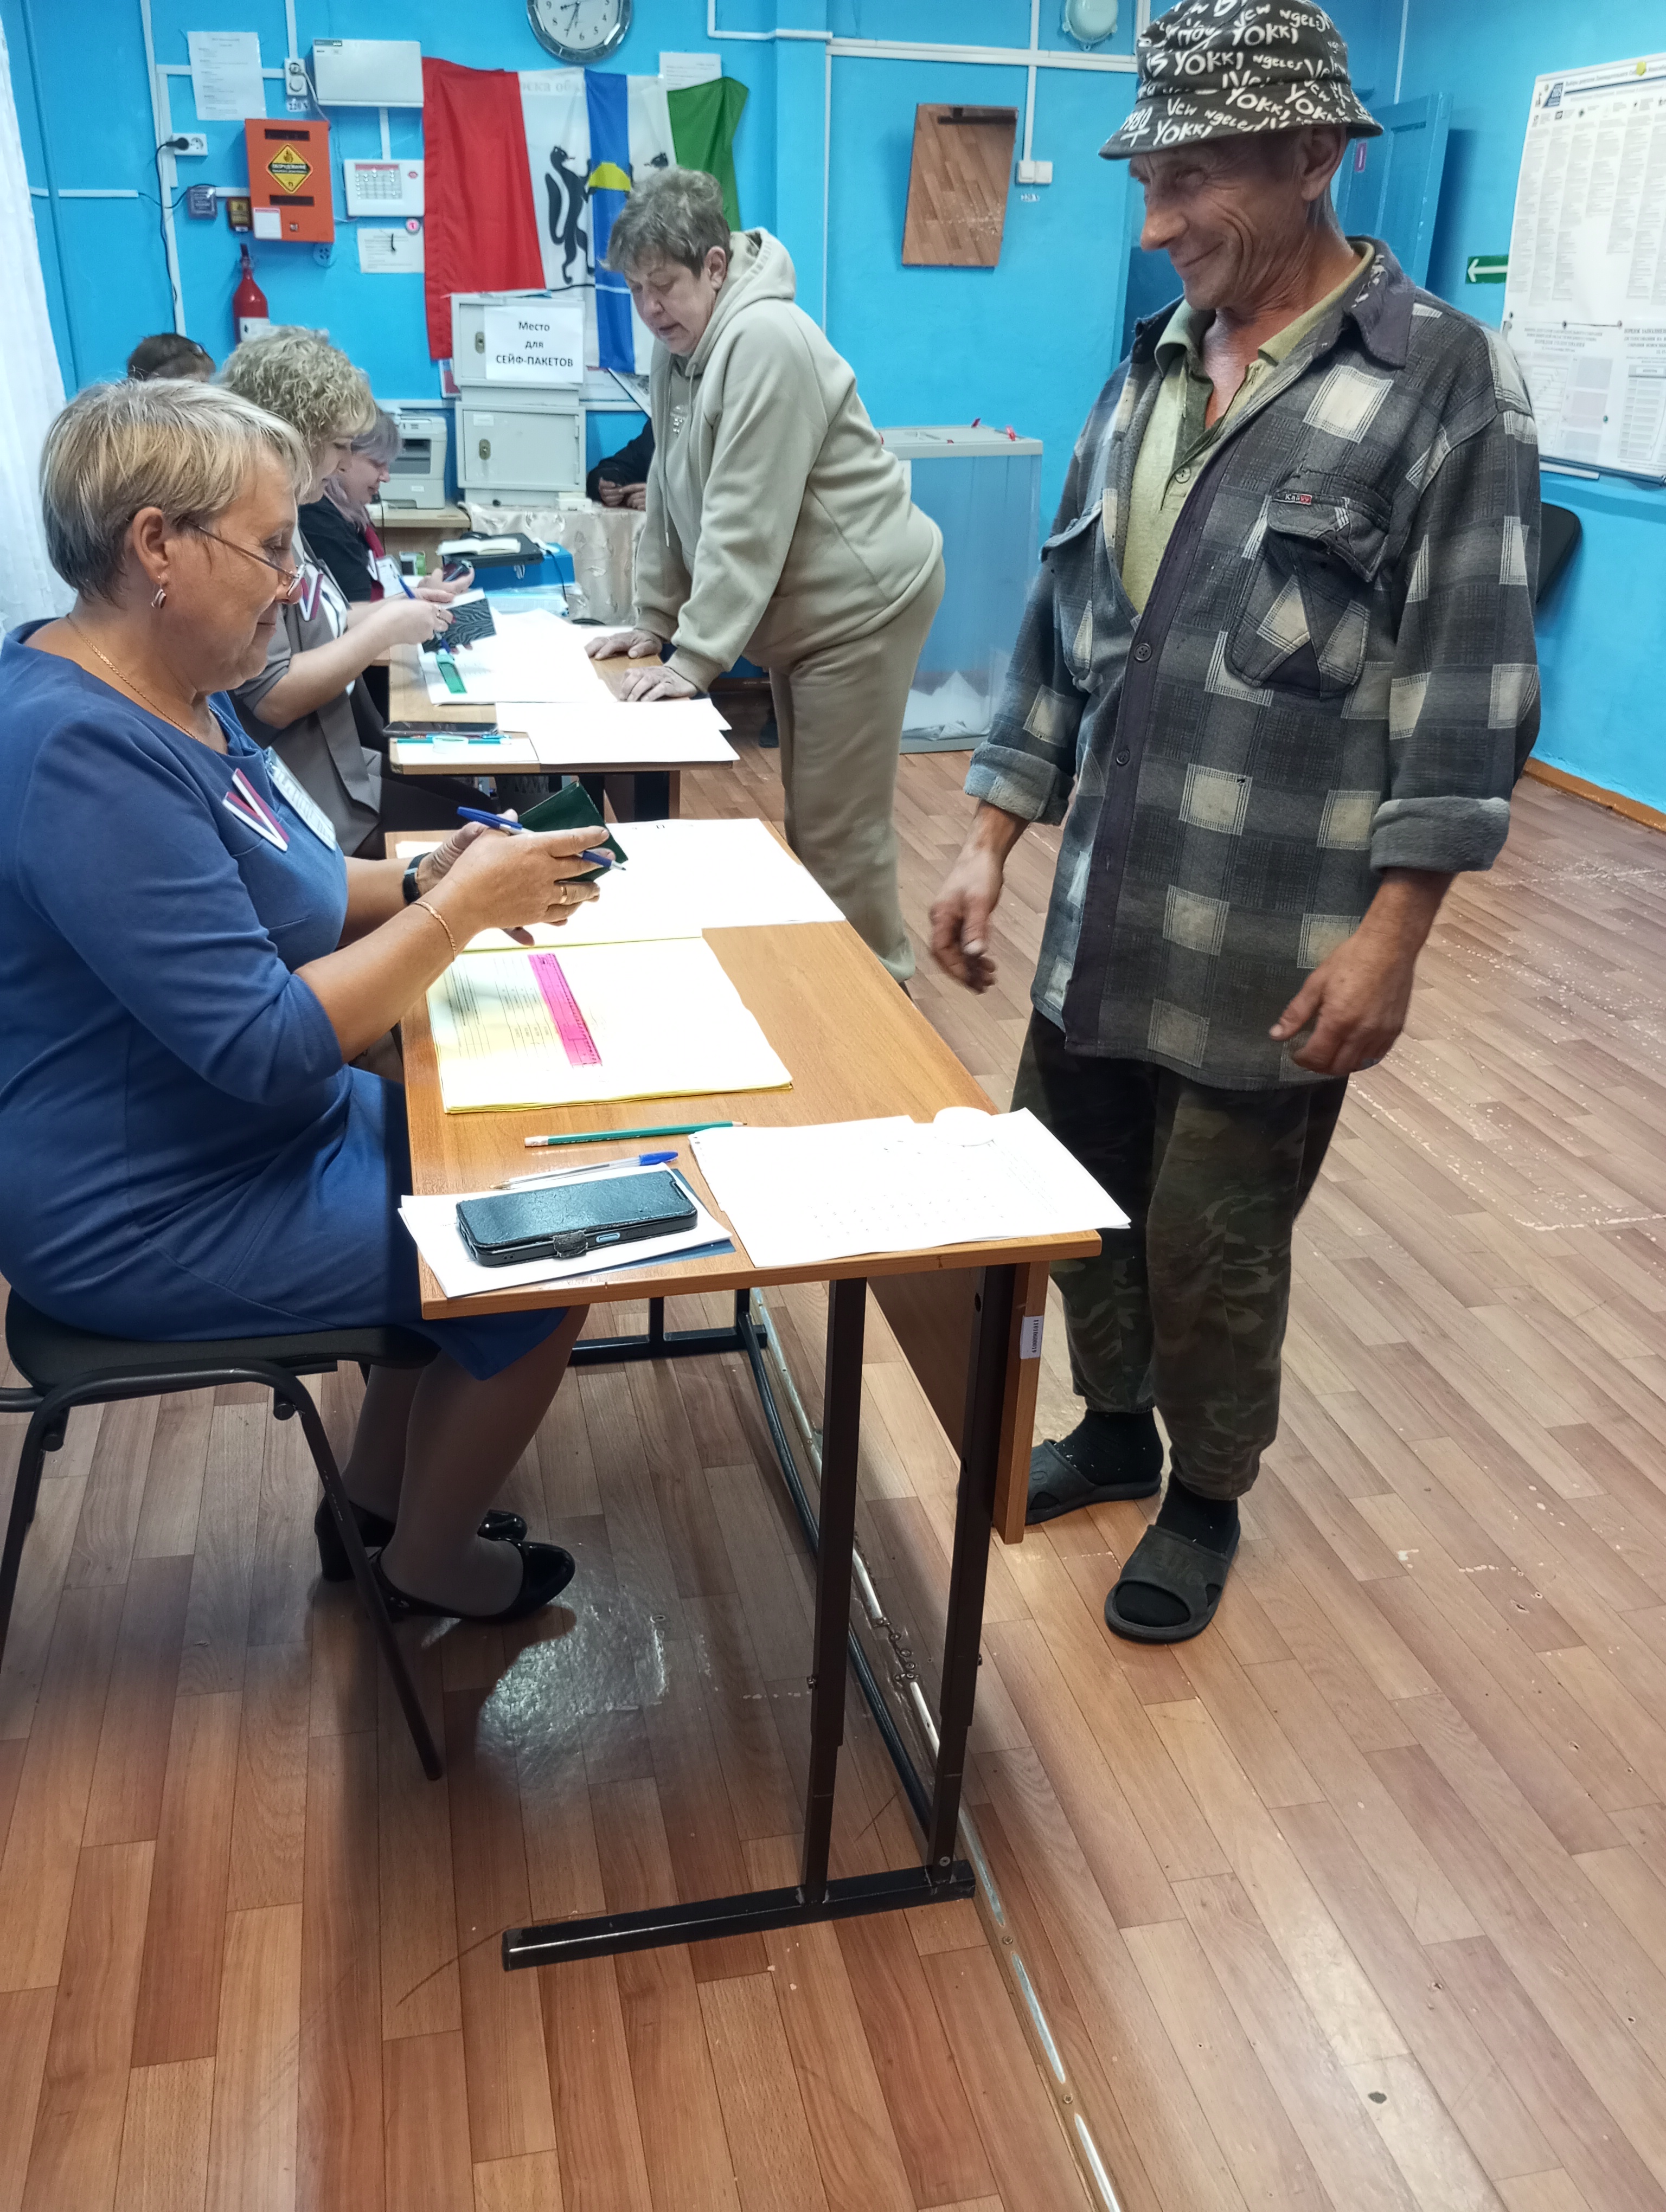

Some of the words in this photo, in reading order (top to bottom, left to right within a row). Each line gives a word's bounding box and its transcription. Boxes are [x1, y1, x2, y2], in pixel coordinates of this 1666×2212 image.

[1232, 23, 1299, 47] YOKKI
[1174, 50, 1244, 76] YOKKI
[1225, 86, 1291, 121] YOKKI
[1152, 118, 1213, 147] YOKKI
[518, 321, 550, 331] Место
[525, 340, 544, 350] для
[496, 353, 574, 367] СЕЙФ-ПАКЕТОВ
